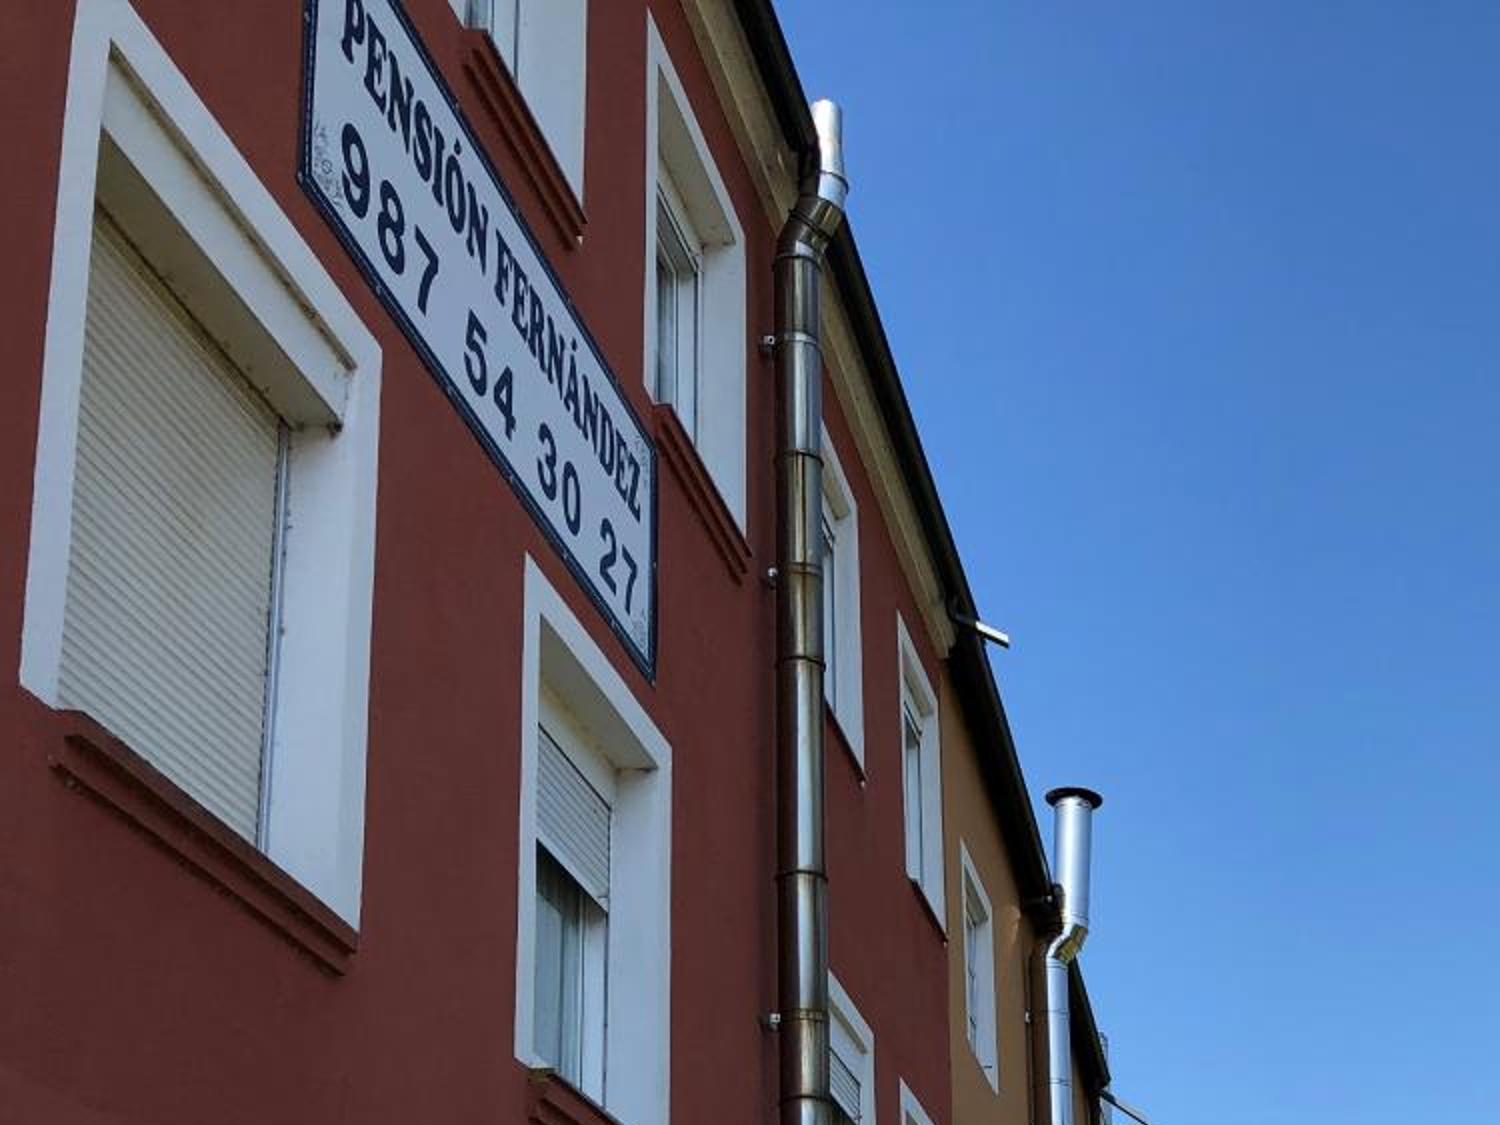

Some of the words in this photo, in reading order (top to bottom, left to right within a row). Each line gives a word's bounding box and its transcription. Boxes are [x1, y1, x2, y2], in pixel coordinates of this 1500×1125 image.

[340, 122, 439, 317] 987
[463, 309, 517, 441] 54
[537, 422, 581, 537] 30
[599, 517, 638, 616] 27
[341, 0, 489, 276] PENSIÓN
[494, 228, 641, 523] FERNÁNDEZ
